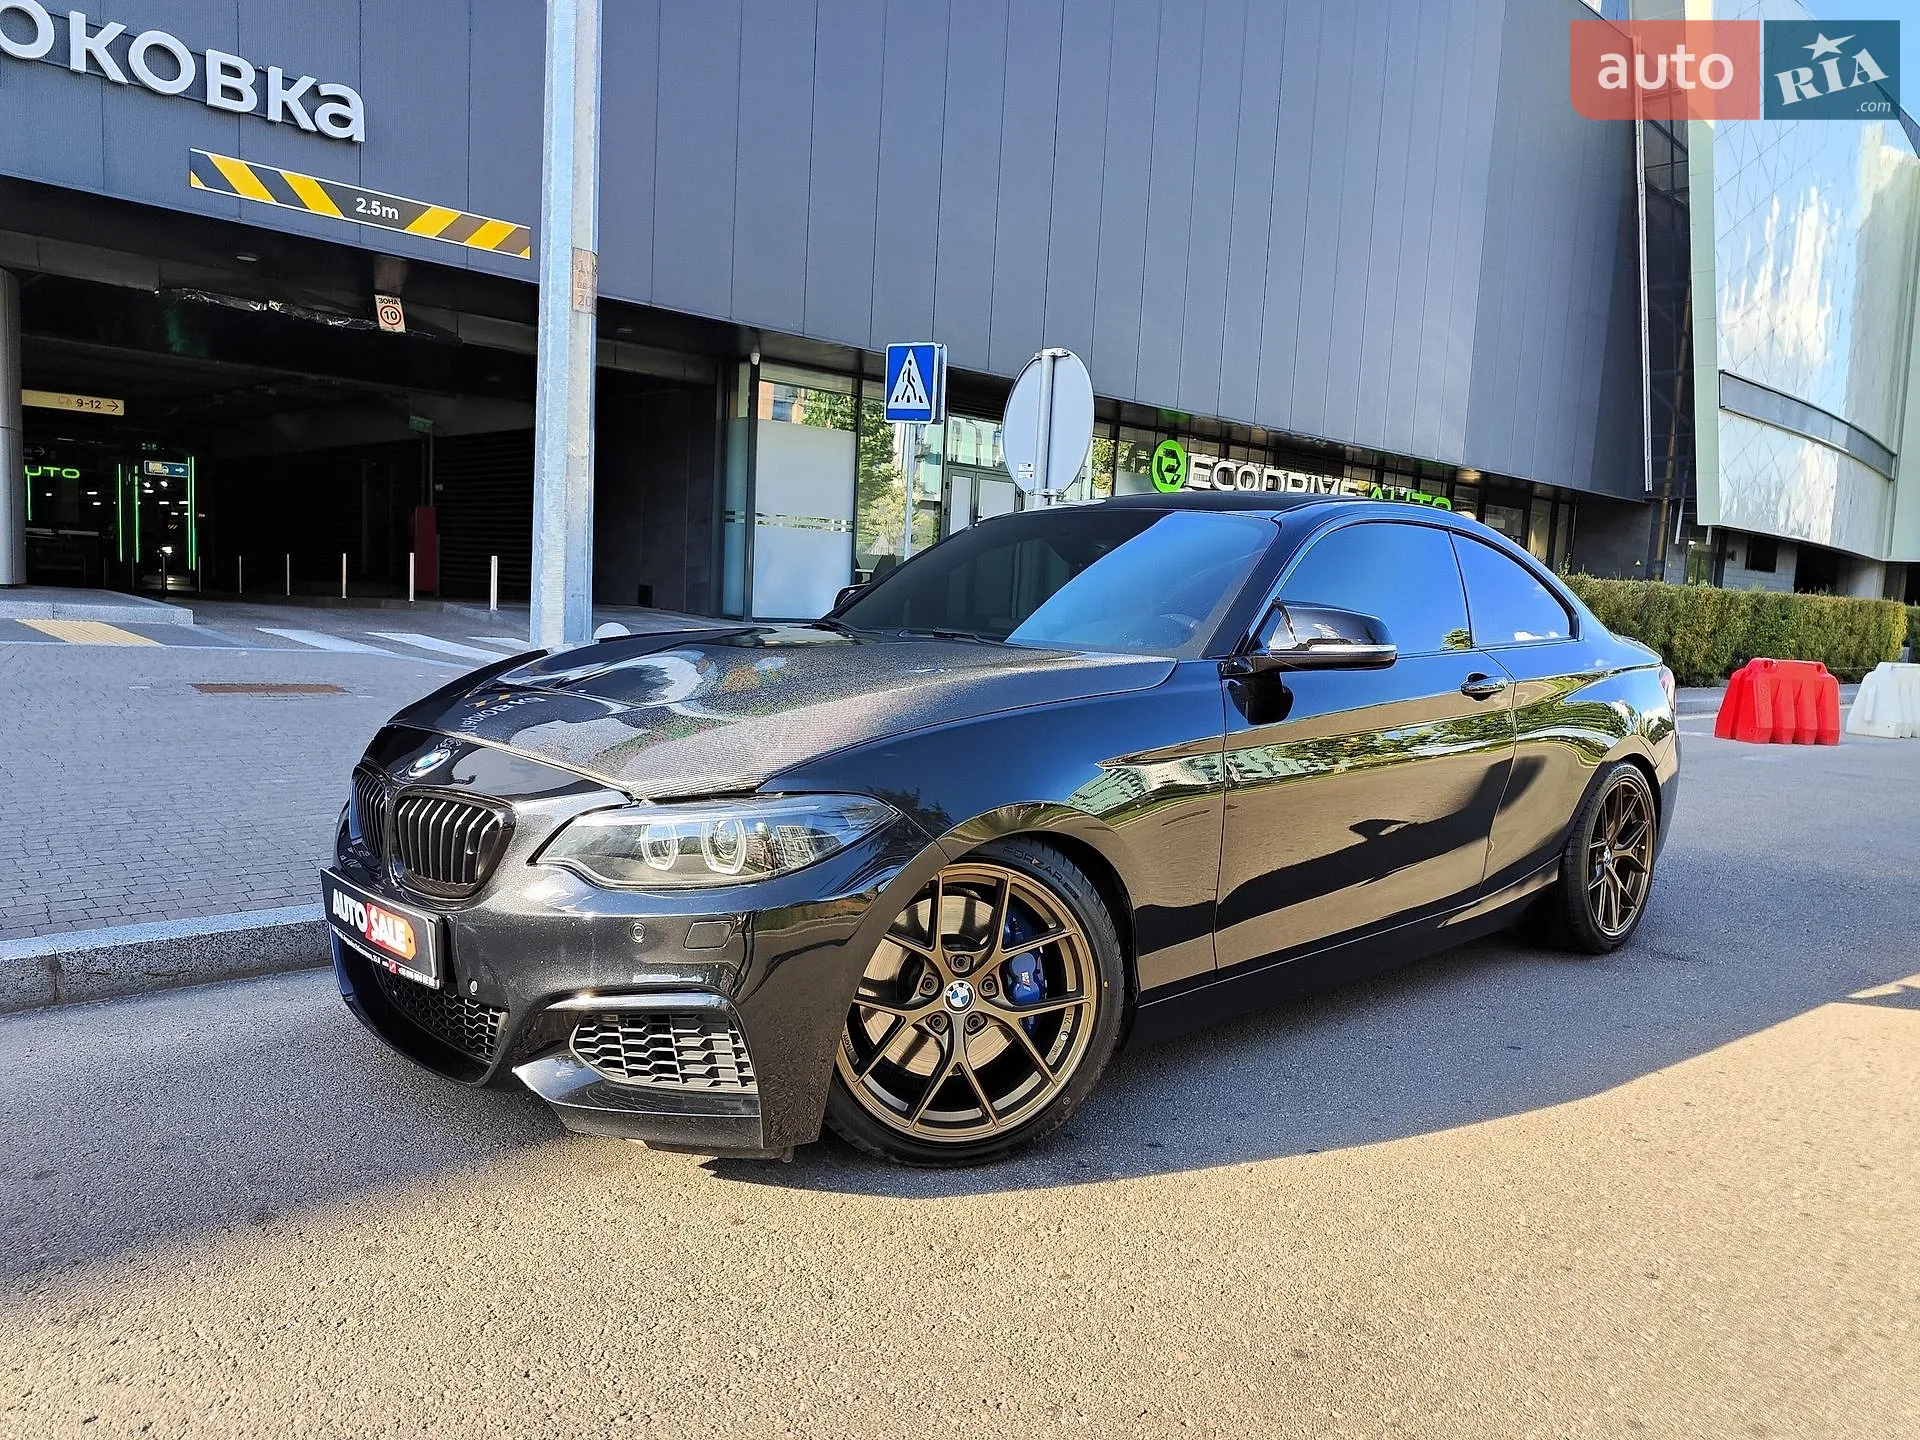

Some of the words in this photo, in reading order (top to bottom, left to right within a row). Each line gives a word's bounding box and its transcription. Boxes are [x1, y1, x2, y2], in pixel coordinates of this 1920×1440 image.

[355, 197, 399, 220] 2.5m
[384, 310, 397, 320] 10
[76, 398, 102, 409] 9-12
[332, 888, 368, 933] AUTO
